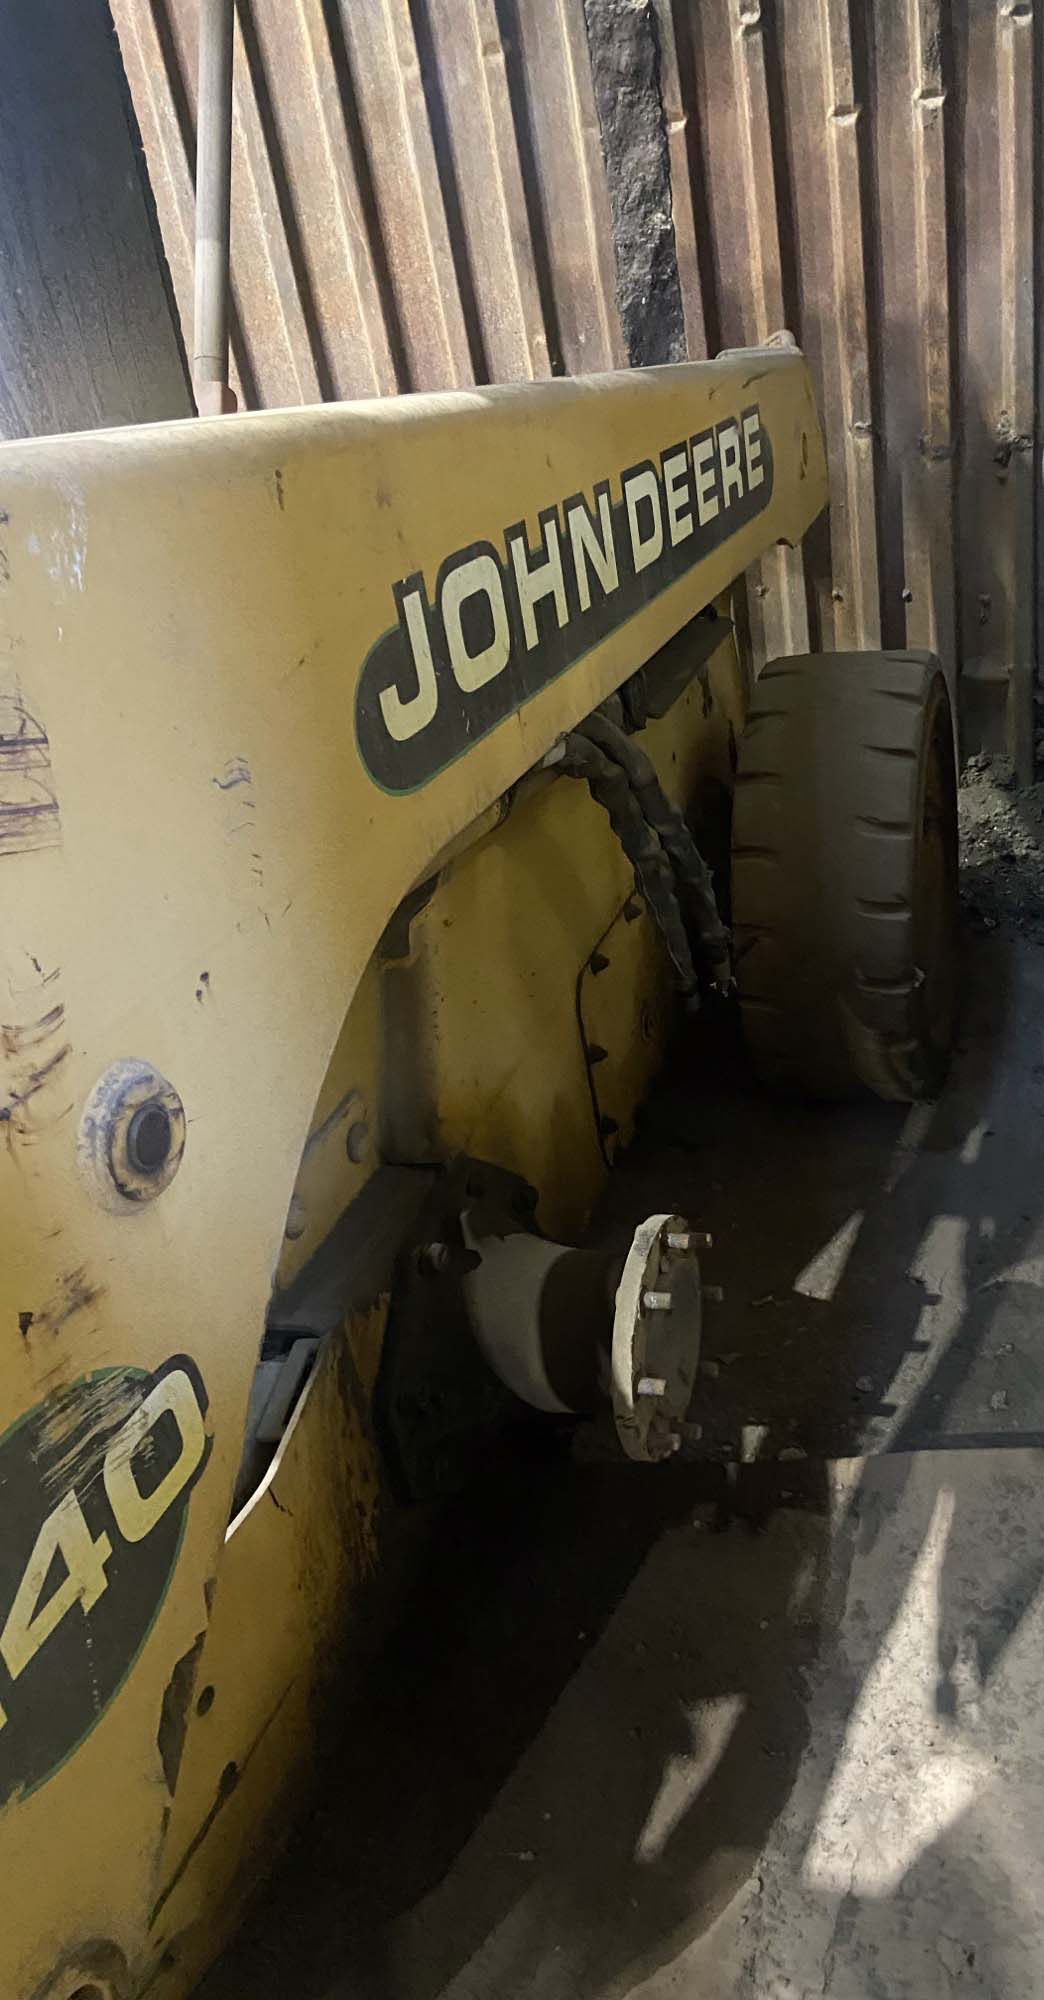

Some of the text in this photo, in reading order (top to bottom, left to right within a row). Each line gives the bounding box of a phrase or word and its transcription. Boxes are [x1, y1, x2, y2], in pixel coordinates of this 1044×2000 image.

[379, 413, 764, 741] JOHN DEERE
[0, 1369, 205, 1731] 40
